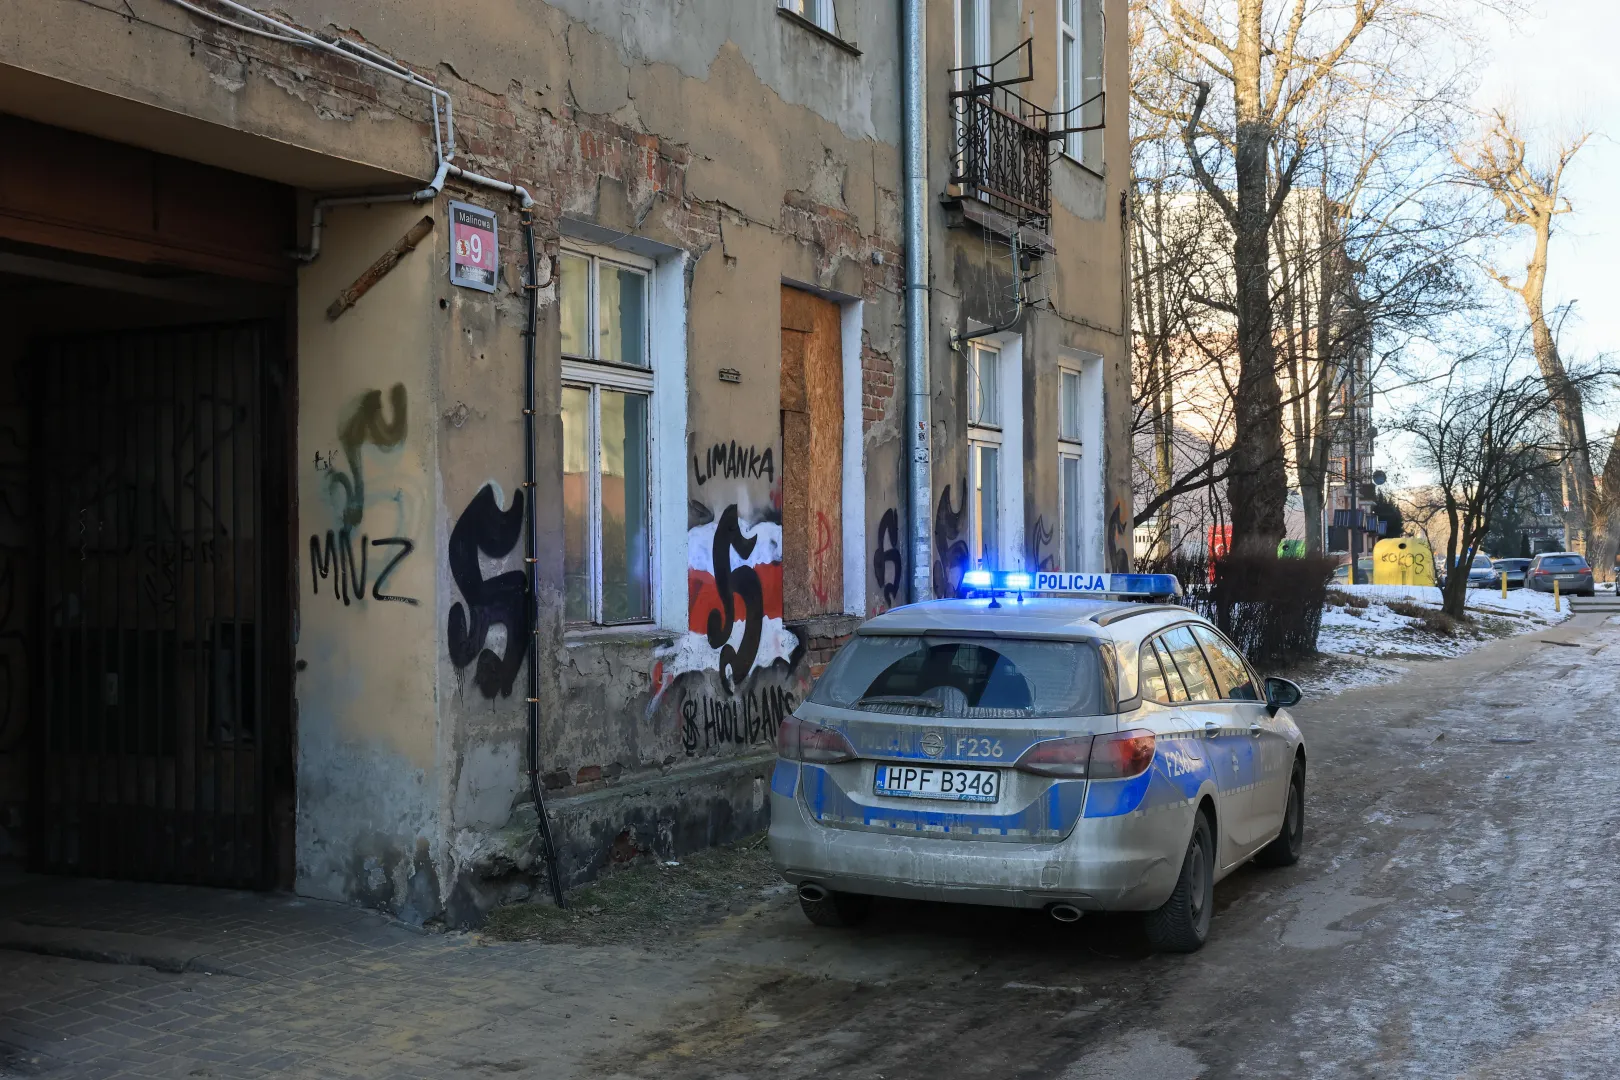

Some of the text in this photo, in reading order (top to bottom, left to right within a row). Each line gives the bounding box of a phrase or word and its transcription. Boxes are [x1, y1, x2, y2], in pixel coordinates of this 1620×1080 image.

[459, 211, 491, 229] Malinowa
[470, 233, 482, 264] 9
[693, 440, 774, 485] LIMANKA
[1038, 574, 1105, 590] POLICJA
[956, 736, 1004, 758] F236
[888, 767, 934, 791] HPF
[941, 770, 995, 796] B346
